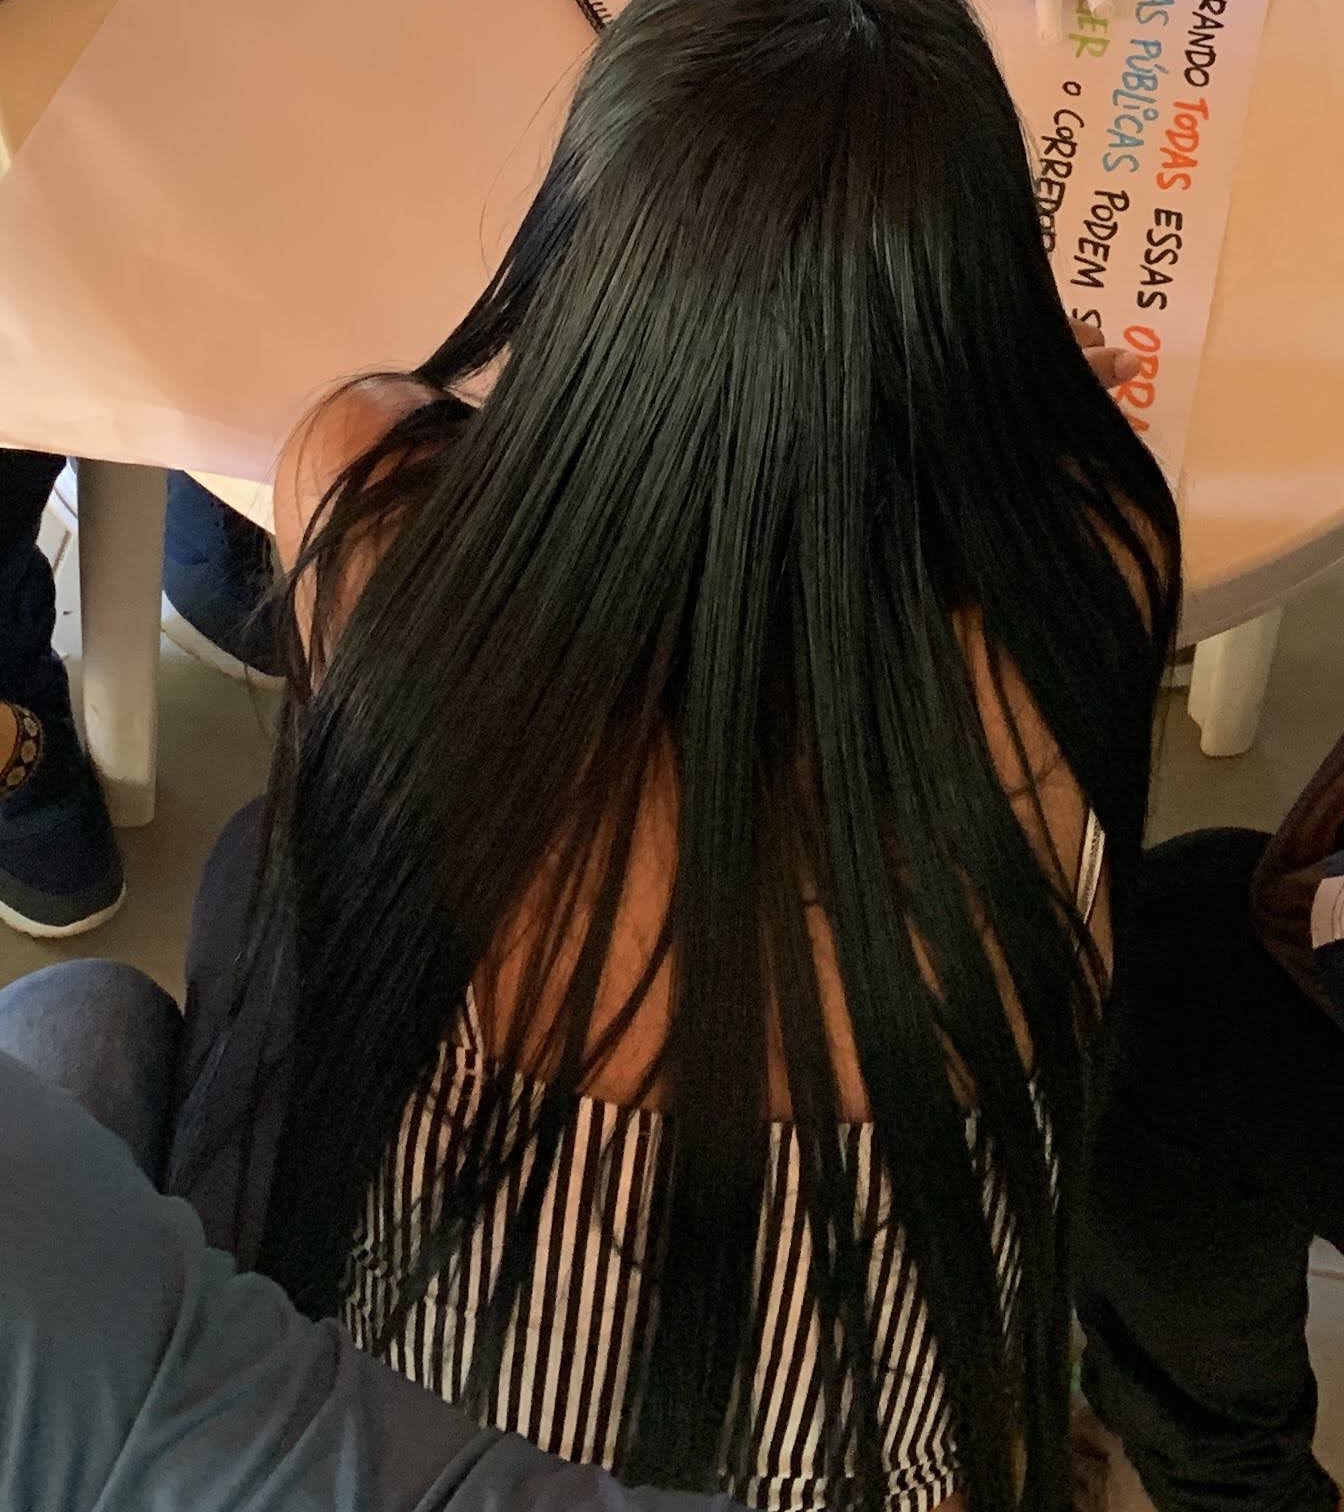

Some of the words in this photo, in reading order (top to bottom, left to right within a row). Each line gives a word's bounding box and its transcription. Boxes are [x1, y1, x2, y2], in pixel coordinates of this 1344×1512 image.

[1102, 38, 1169, 173] PÚBLICAS
[1155, 96, 1209, 192] TODAS
[1070, 190, 1130, 288] PODEM
[1136, 208, 1184, 311] ESSAS
